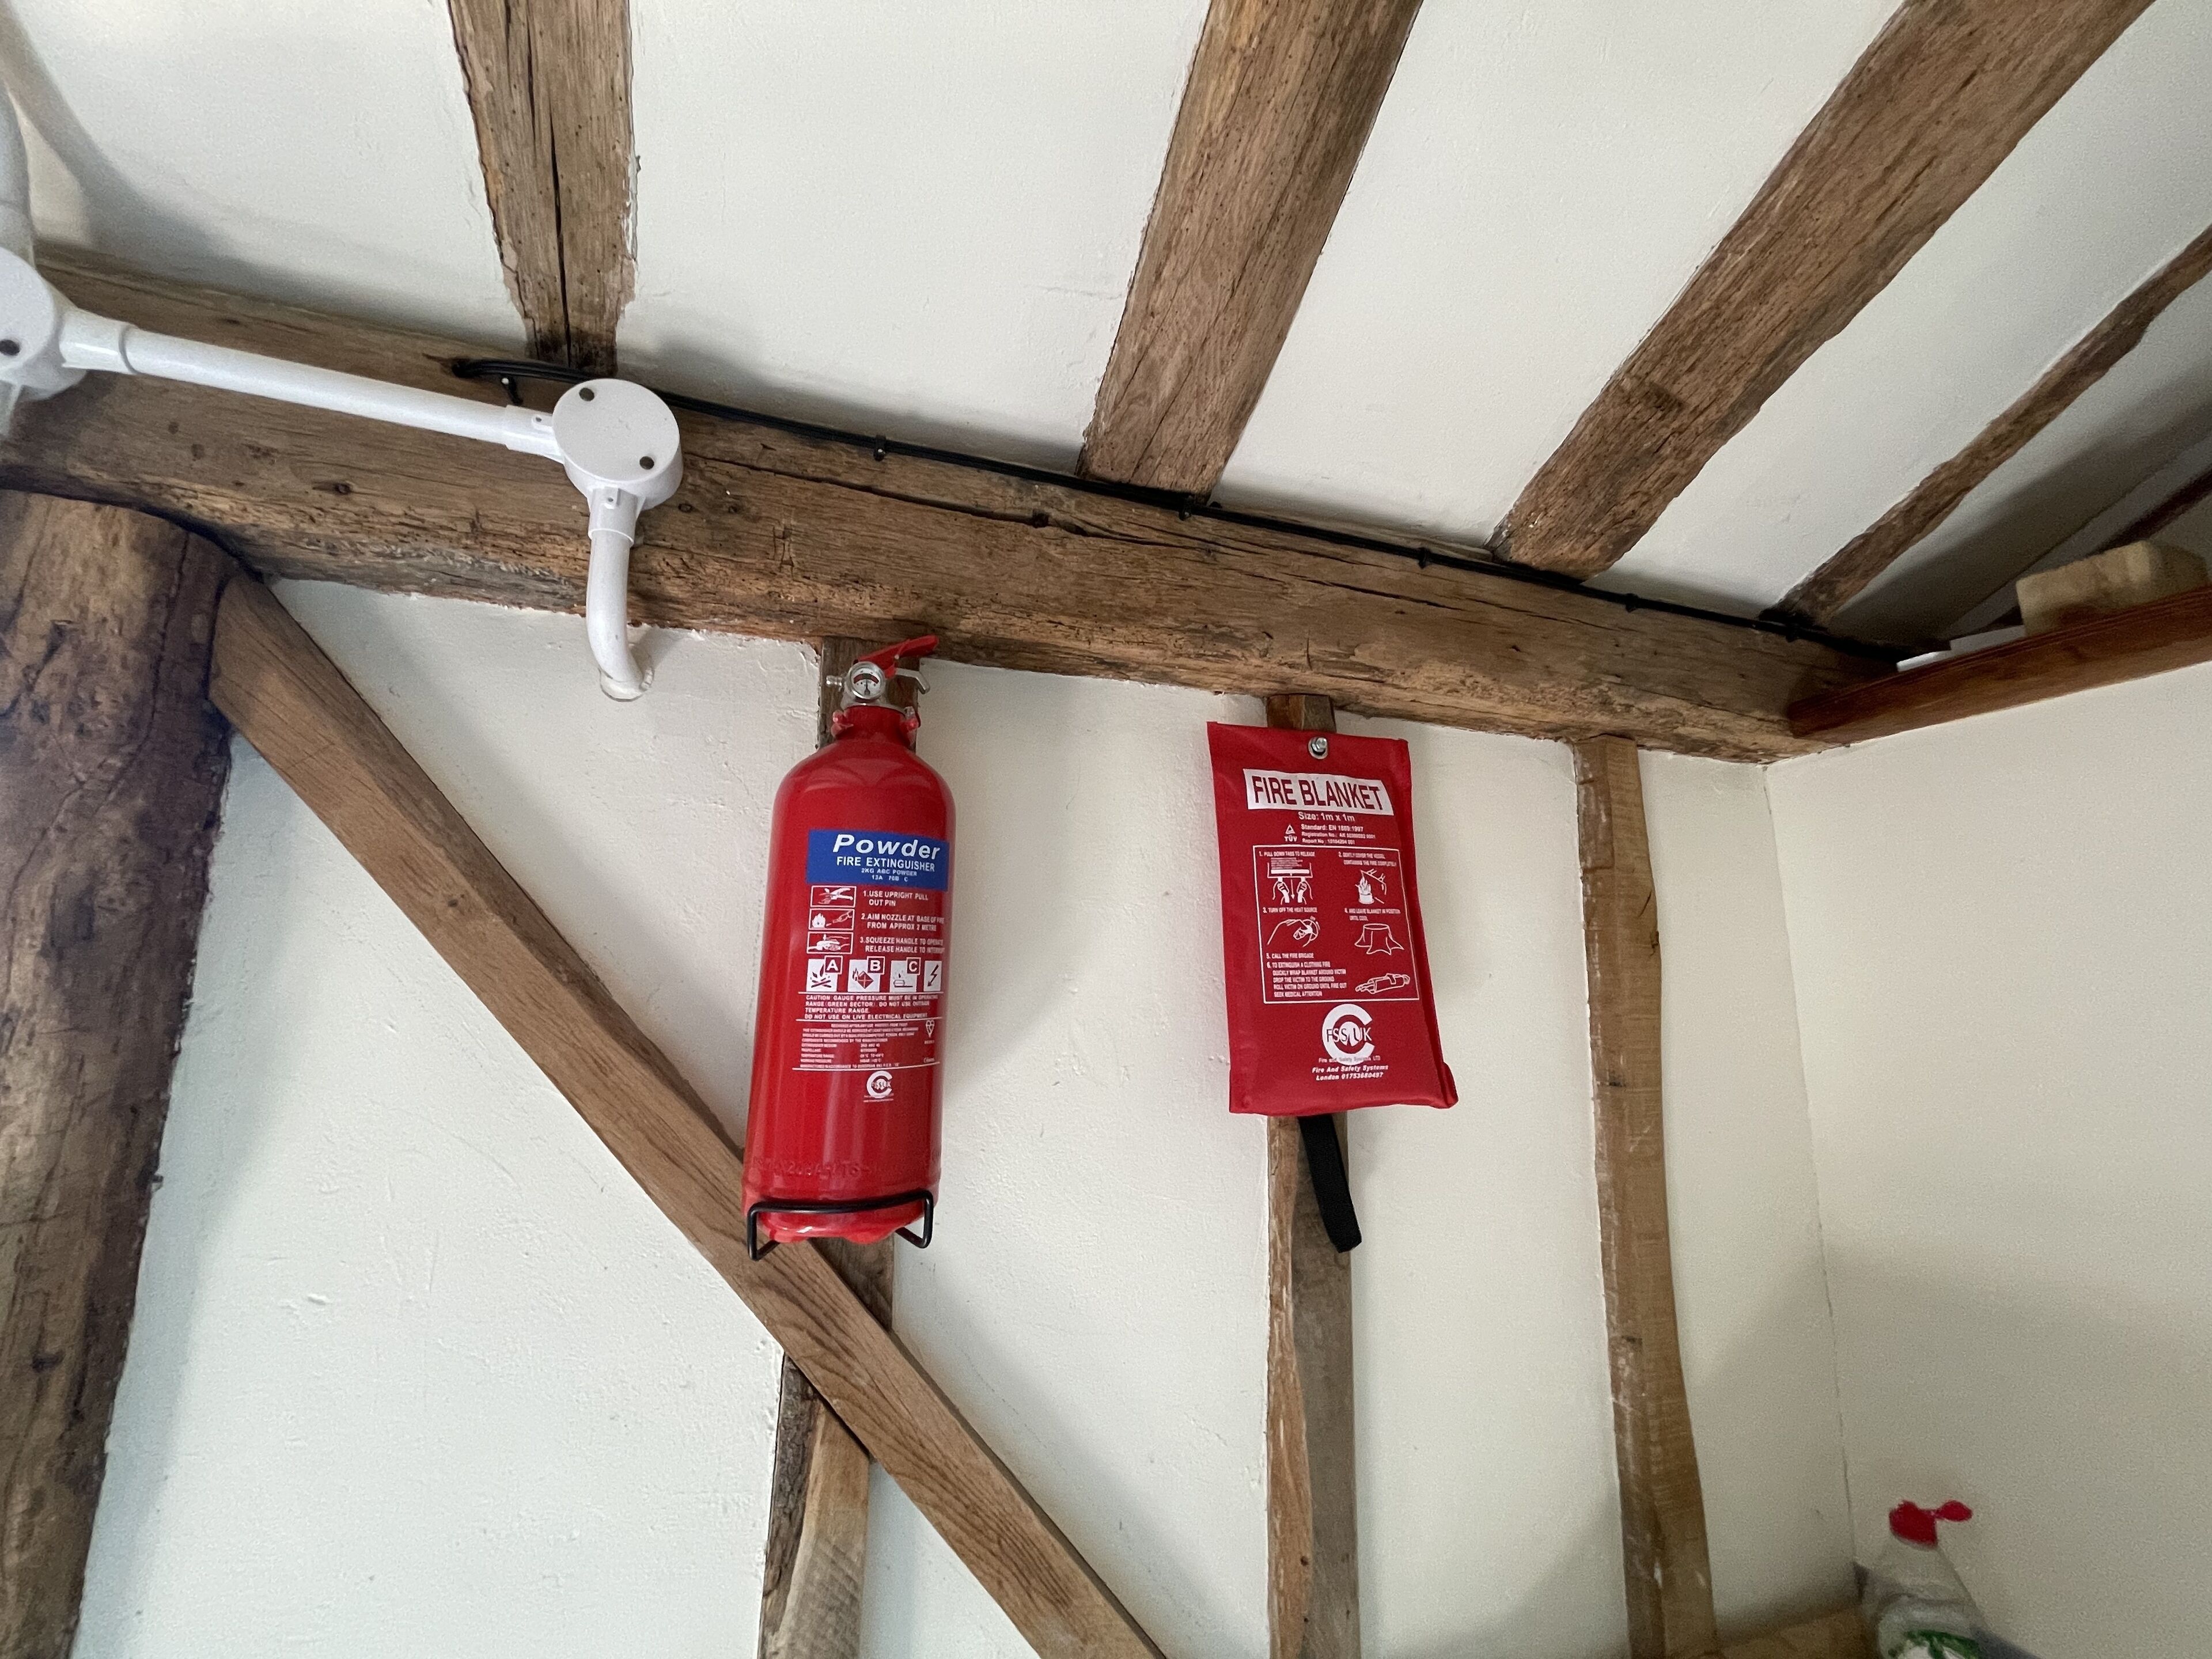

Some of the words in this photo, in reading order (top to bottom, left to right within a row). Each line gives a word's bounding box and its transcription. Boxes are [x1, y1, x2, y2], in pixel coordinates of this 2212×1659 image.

[1252, 776, 1297, 805] FIRE
[1298, 779, 1383, 810] BLANKET
[1298, 811, 1319, 820] Size:
[1321, 812, 1334, 821] 1m
[1342, 813, 1355, 822] 1m
[1284, 834, 1297, 842] TÜV
[833, 834, 941, 860] Powder
[836, 857, 861, 866] FIRE
[866, 857, 935, 872] EXTINGUISHER
[881, 914, 907, 922] NOZZLE
[827, 959, 838, 971] A
[870, 960, 881, 971] B
[908, 961, 918, 972] C
